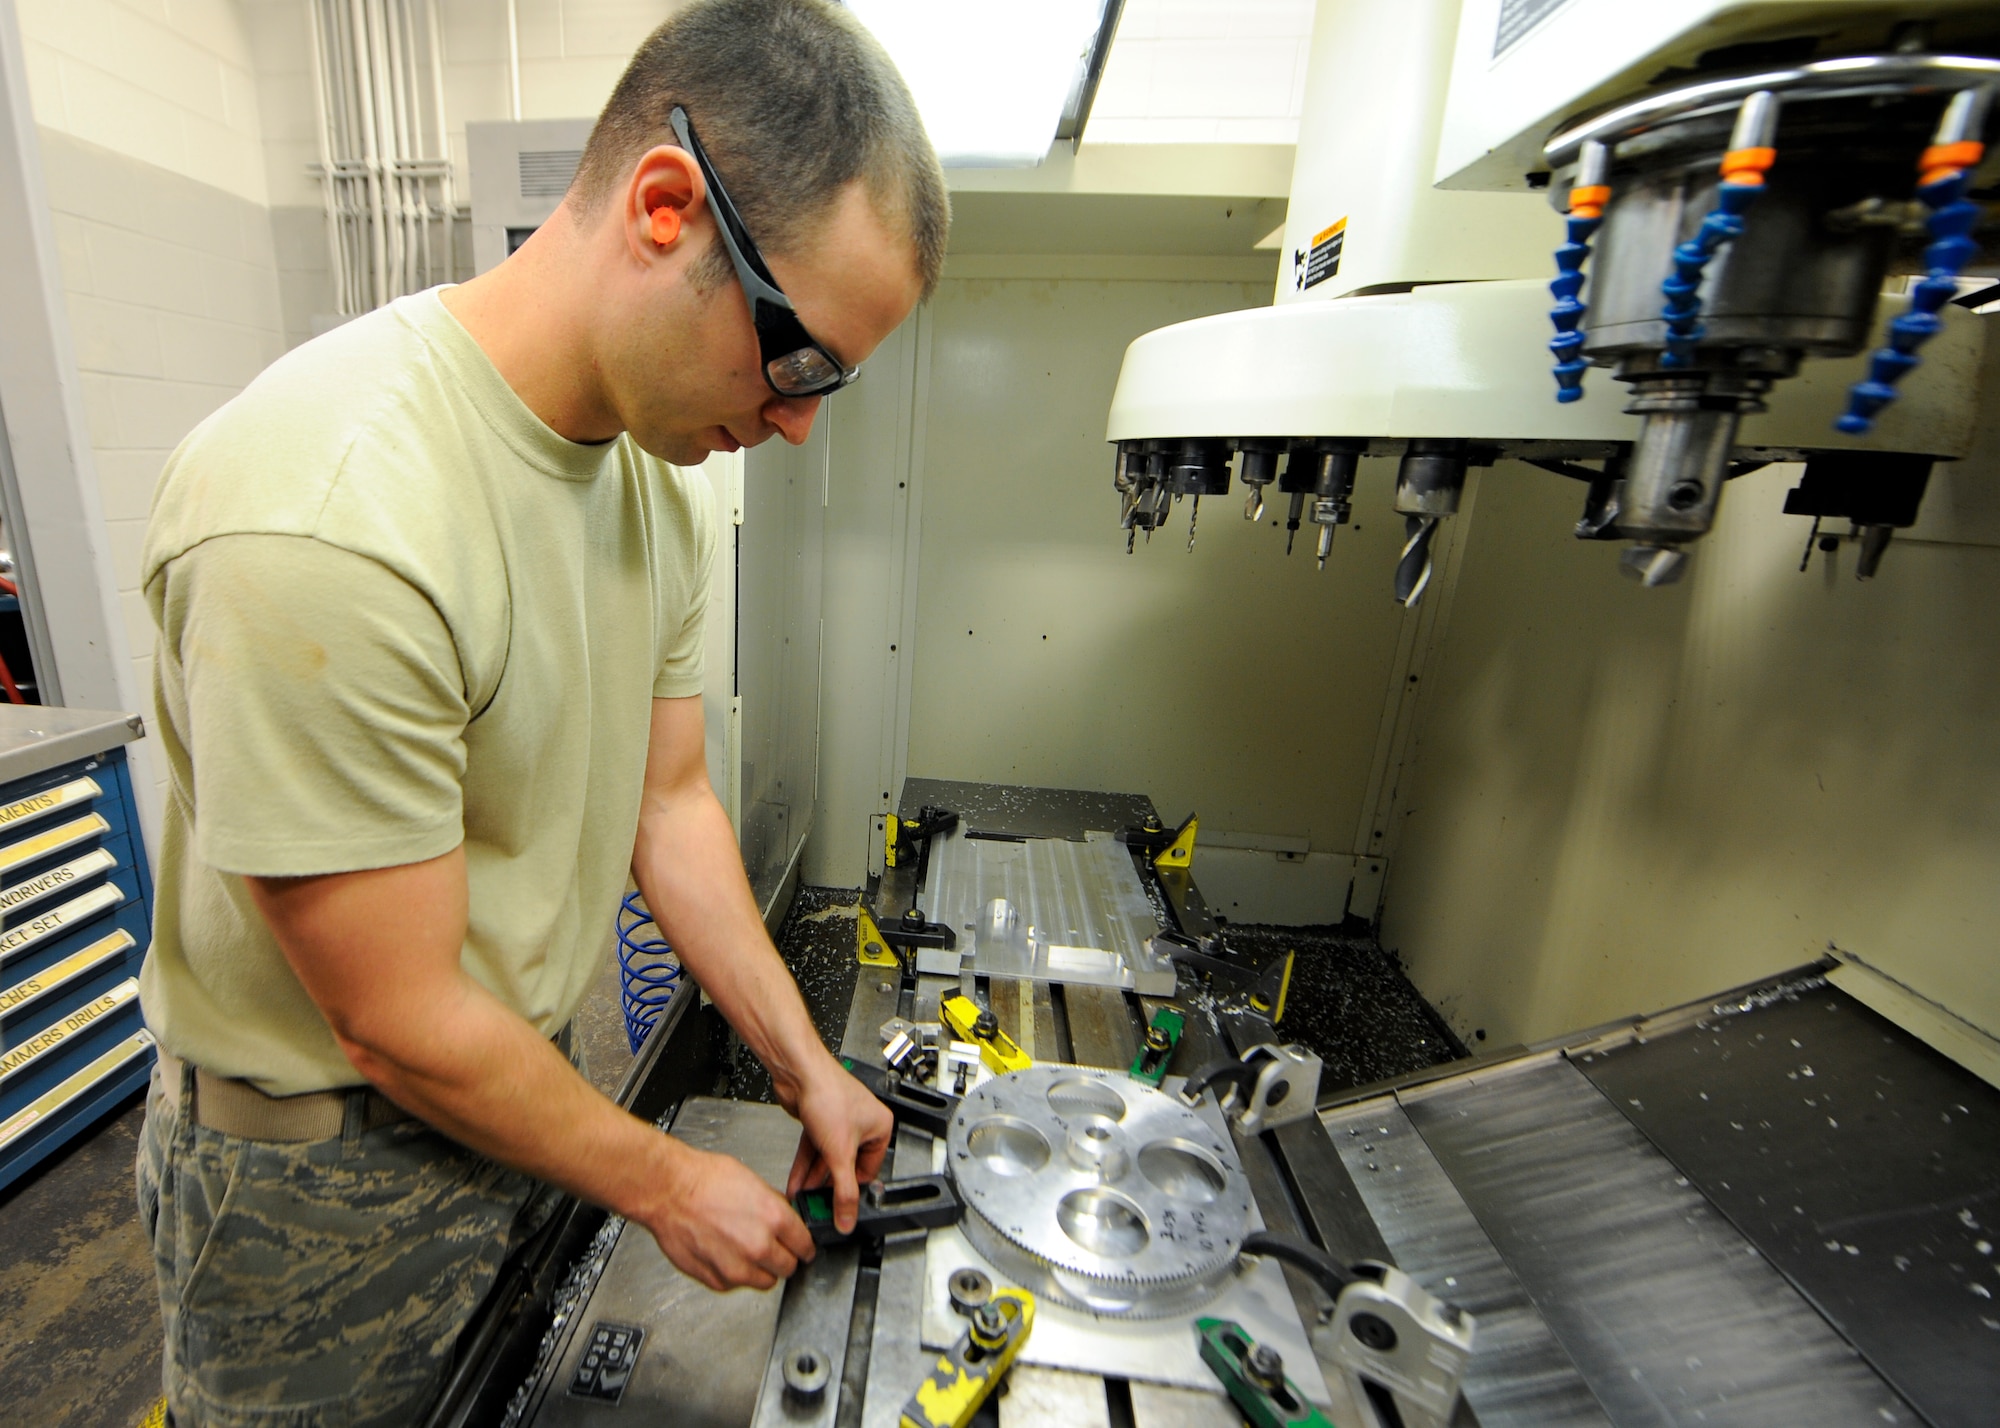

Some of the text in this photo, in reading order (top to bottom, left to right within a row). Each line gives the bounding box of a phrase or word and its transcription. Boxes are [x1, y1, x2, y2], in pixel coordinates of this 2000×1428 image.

[32, 912, 63, 934] SET
[65, 996, 116, 1031] DRILLS
[579, 1331, 610, 1382] step
